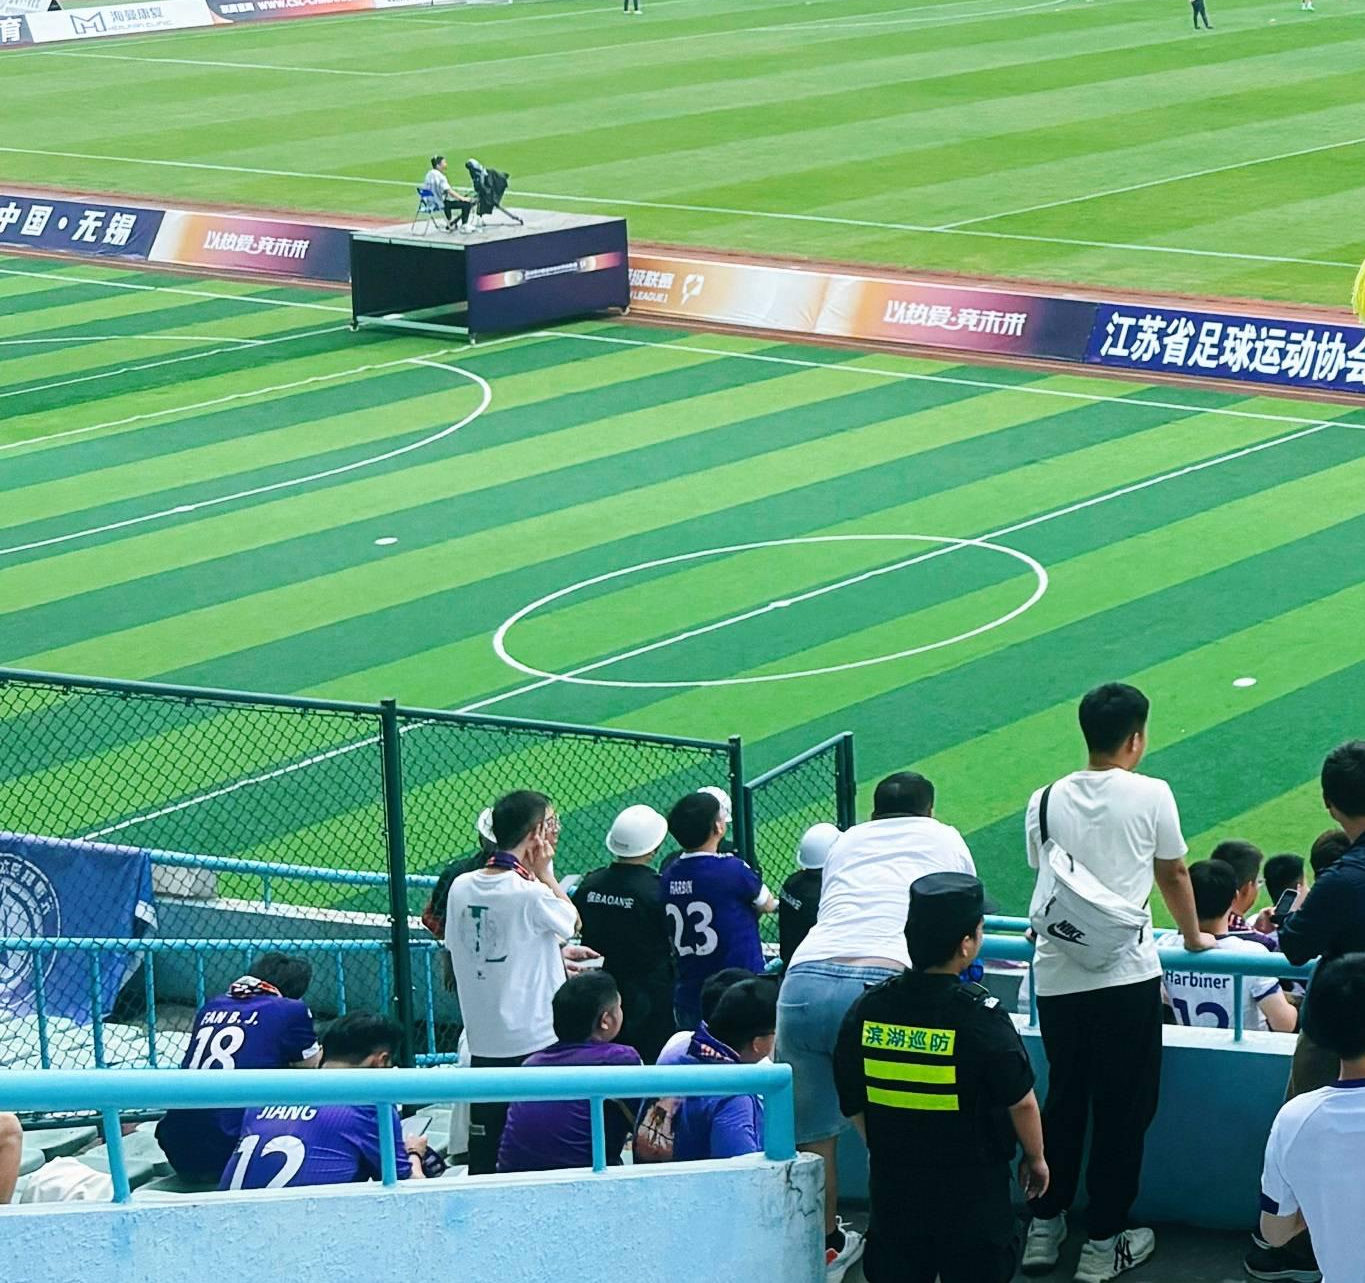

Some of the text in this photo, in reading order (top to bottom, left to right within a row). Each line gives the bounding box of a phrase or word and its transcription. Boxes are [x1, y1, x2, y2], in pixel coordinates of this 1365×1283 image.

[665, 901, 719, 956] 23
[1056, 919, 1087, 942] NIKE
[200, 1011, 228, 1025] FAN
[244, 1012, 259, 1026] J.
[189, 1026, 245, 1070] 18
[865, 1025, 951, 1052] 滨湖巡防
[256, 1105, 318, 1121] JIANG
[229, 1134, 306, 1191] 12
